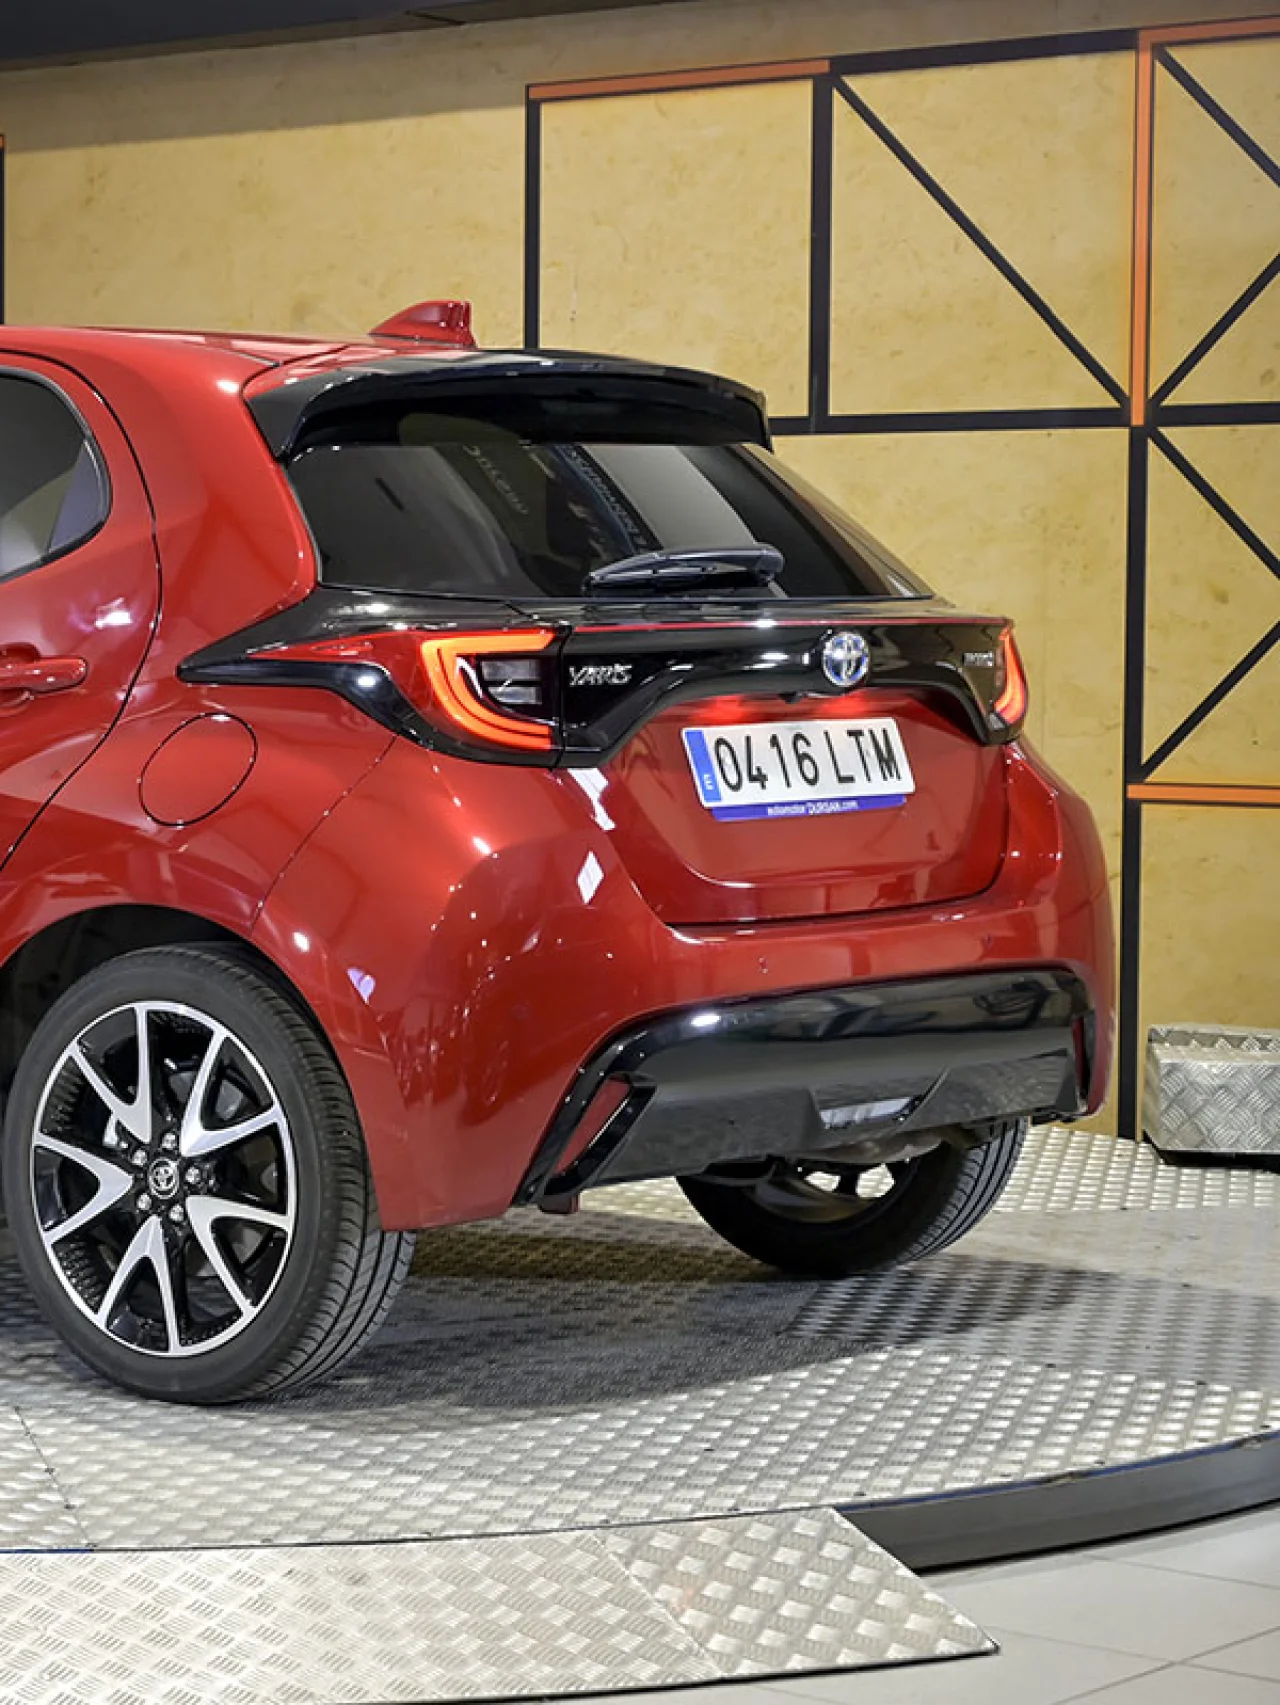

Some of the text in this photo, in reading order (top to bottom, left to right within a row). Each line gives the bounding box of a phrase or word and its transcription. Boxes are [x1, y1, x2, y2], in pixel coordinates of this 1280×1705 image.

[569, 664, 632, 686] YARIS
[715, 728, 901, 792] 0416 LTM
